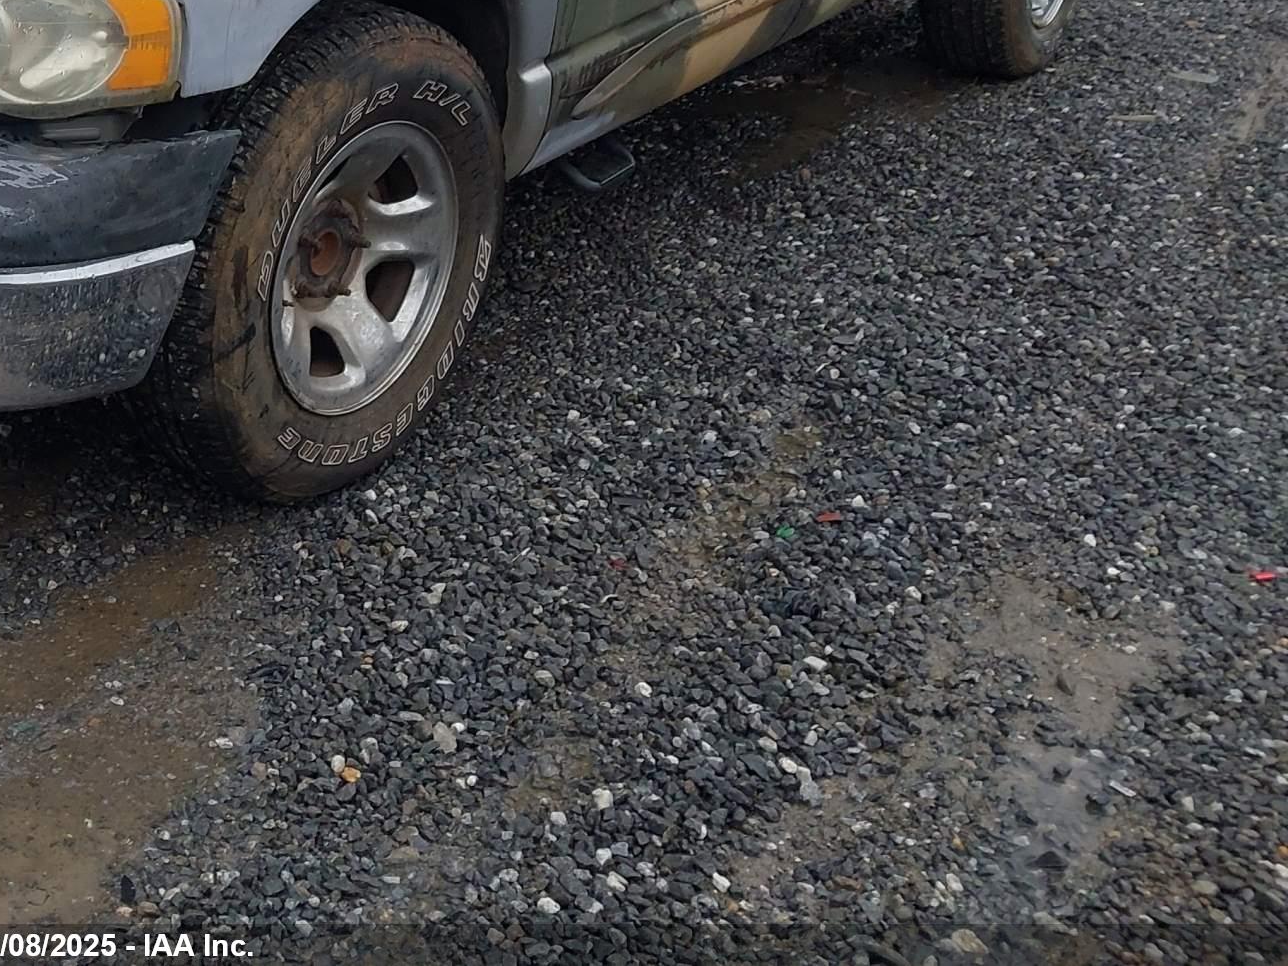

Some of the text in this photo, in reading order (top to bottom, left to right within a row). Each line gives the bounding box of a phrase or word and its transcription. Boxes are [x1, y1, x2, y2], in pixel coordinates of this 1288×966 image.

[257, 81, 473, 302] DUELER H/L
[278, 233, 493, 466] BRIDGESTONE
